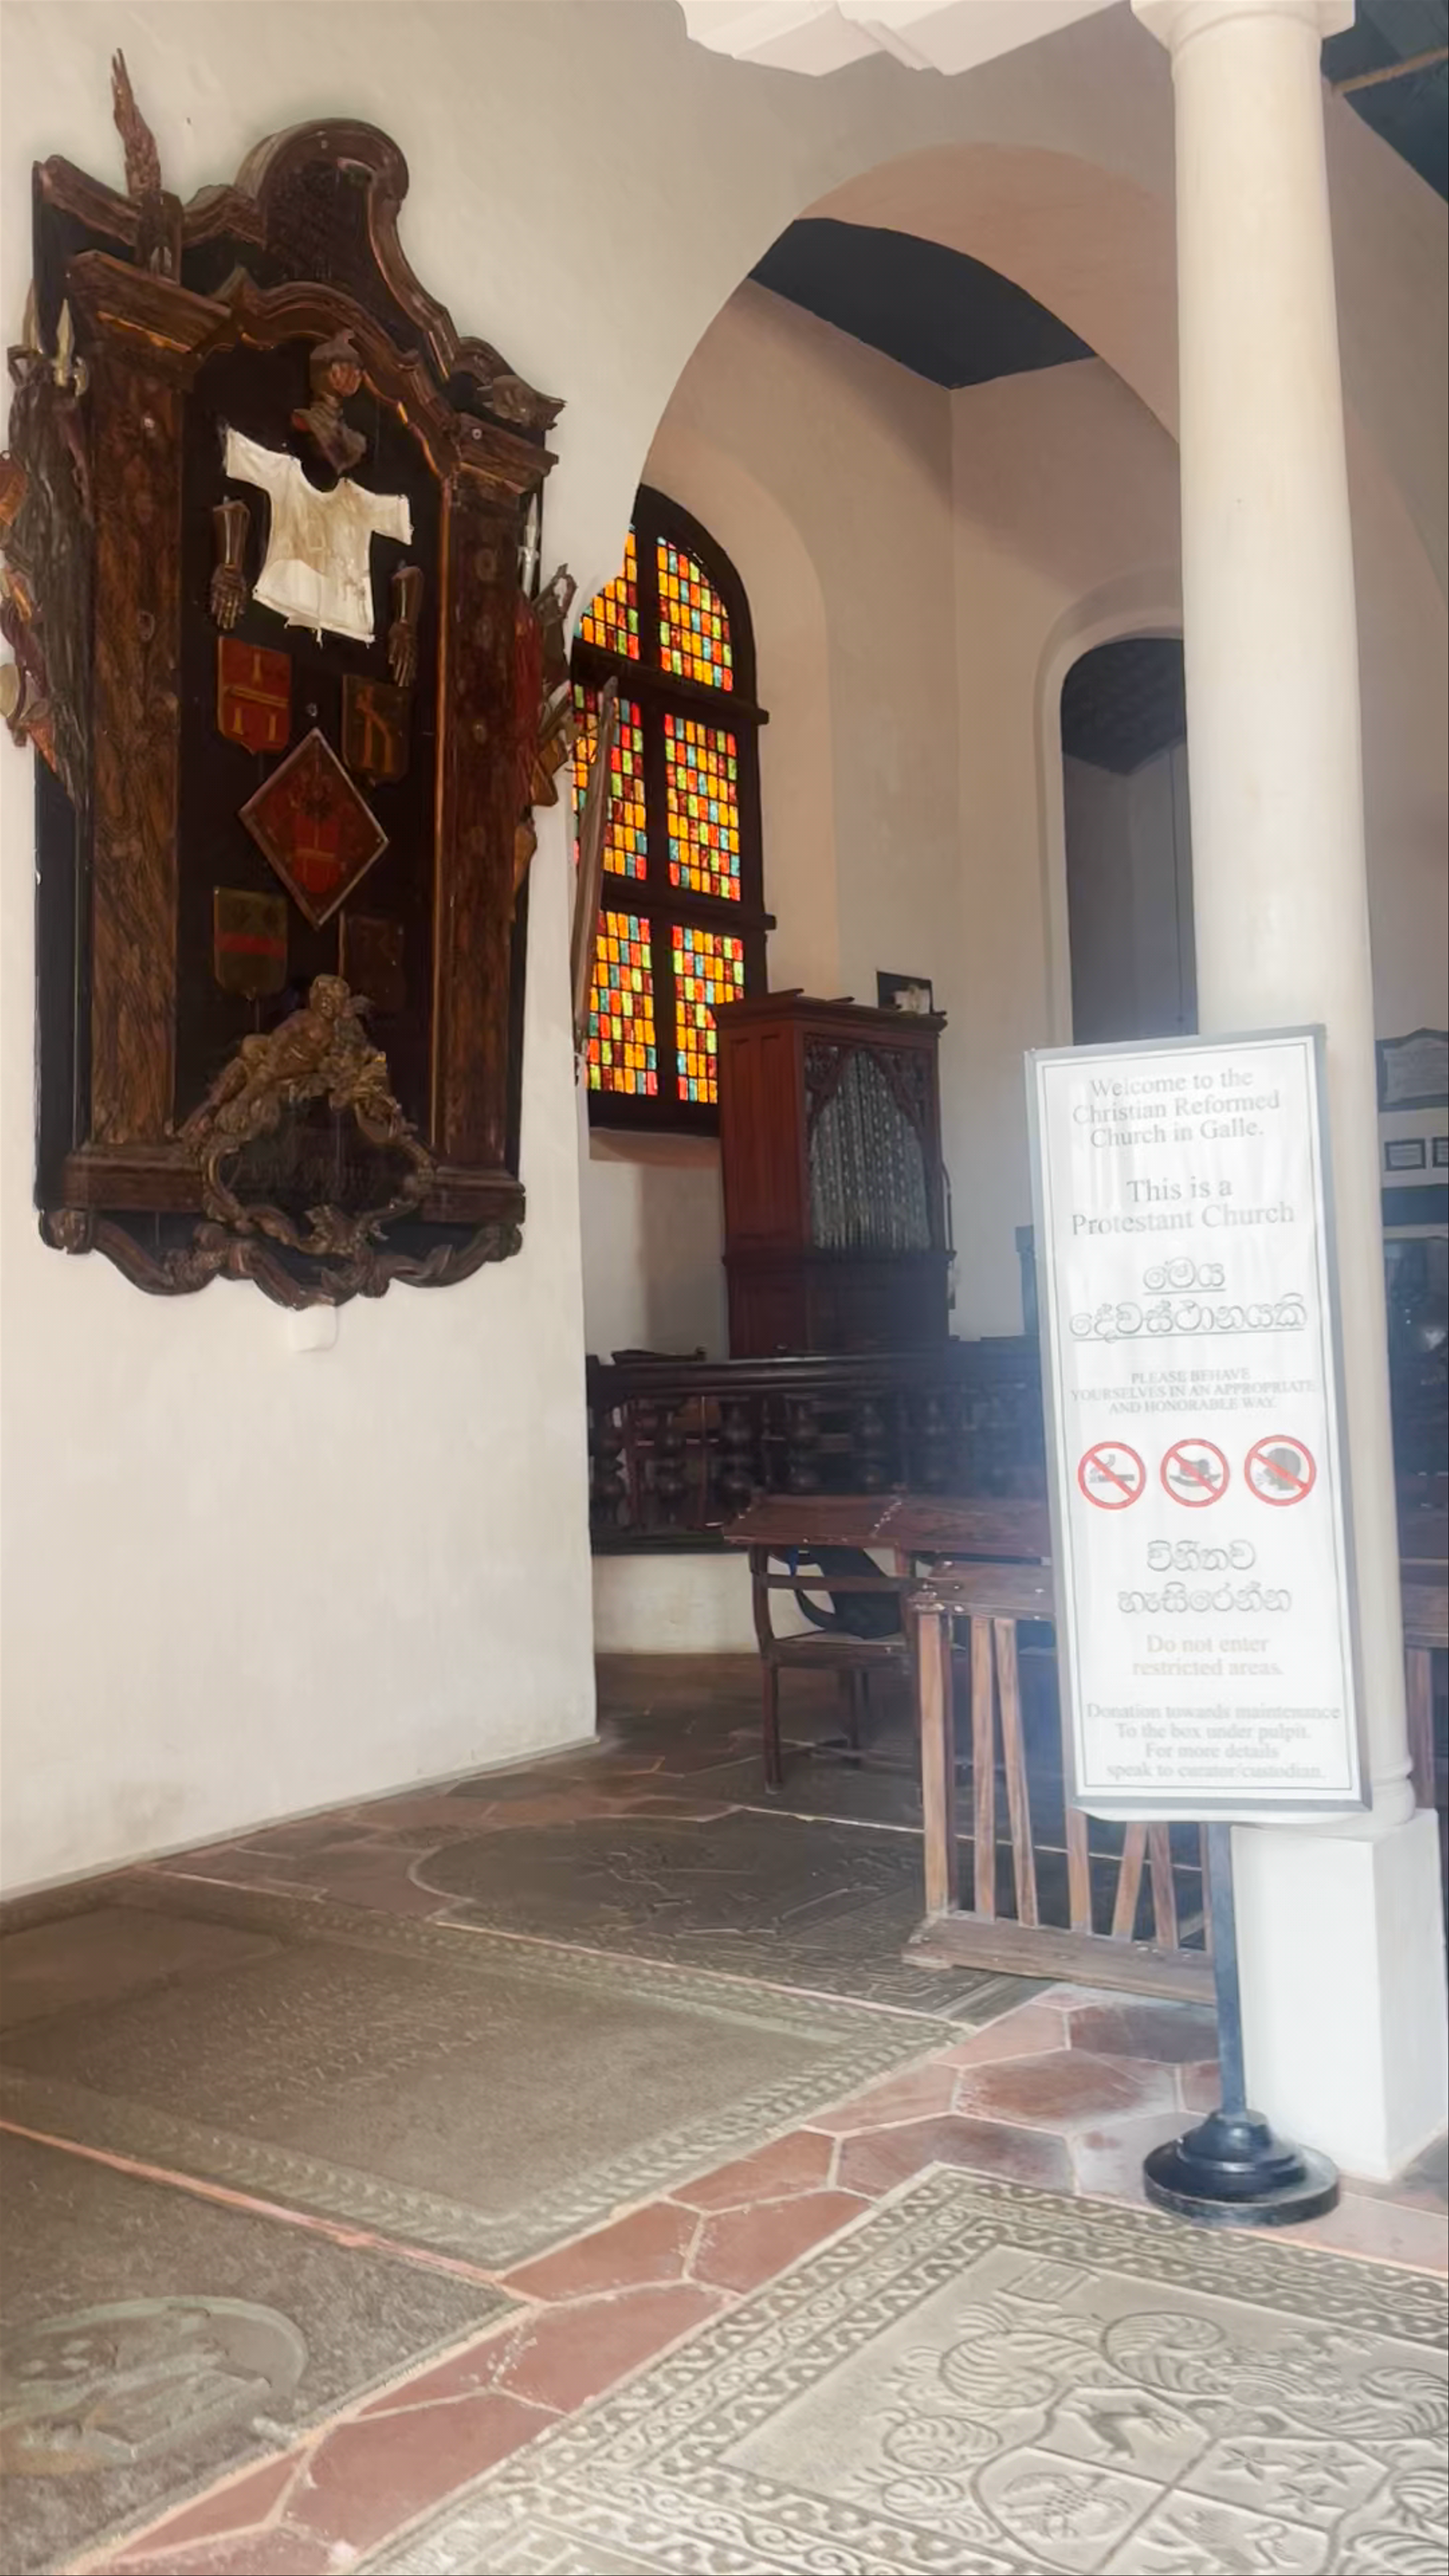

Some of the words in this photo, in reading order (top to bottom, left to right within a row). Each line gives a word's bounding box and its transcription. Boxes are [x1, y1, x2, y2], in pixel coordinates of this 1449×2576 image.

[1091, 1074, 1186, 1097] Welcome
[1194, 1073, 1213, 1090] to
[1220, 1068, 1254, 1088] the
[1073, 1099, 1166, 1125] Christian
[1174, 1089, 1280, 1116] Reformed
[1091, 1124, 1166, 1148] Church
[1174, 1122, 1192, 1141] in
[1200, 1118, 1263, 1139] Galle.
[1127, 1177, 1181, 1202] This
[1191, 1176, 1210, 1198] is
[1219, 1180, 1232, 1197] a
[1072, 1209, 1194, 1235] Protestant
[1201, 1202, 1294, 1228] Church
[1132, 1371, 1186, 1384] PLEASE
[1191, 1368, 1250, 1381] BEHAVE
[1071, 1386, 1168, 1401] YOURSELVES
[1170, 1385, 1185, 1397] IN
[1190, 1384, 1214, 1396] AN
[1215, 1380, 1314, 1395] APPROPRIATE
[1109, 1401, 1141, 1415] AND
[1144, 1398, 1238, 1413] HONORABLE
[1146, 1635, 1176, 1653] Do
[1182, 1637, 1212, 1653] not
[1220, 1637, 1270, 1653] enter
[1132, 1659, 1223, 1676] restricted
[1228, 1662, 1284, 1675] areas.
[1087, 1703, 1161, 1718] Donation
[1166, 1704, 1230, 1718] towards
[1236, 1702, 1340, 1718] maintenance
[1116, 1723, 1137, 1738] To
[1141, 1723, 1166, 1738] the
[1171, 1723, 1200, 1738] box
[1207, 1724, 1252, 1738] under
[1146, 1742, 1172, 1758] For
[1178, 1747, 1220, 1758] more
[1225, 1744, 1279, 1758] details
[1107, 1762, 1152, 1780] speak
[1157, 1764, 1174, 1777] to
